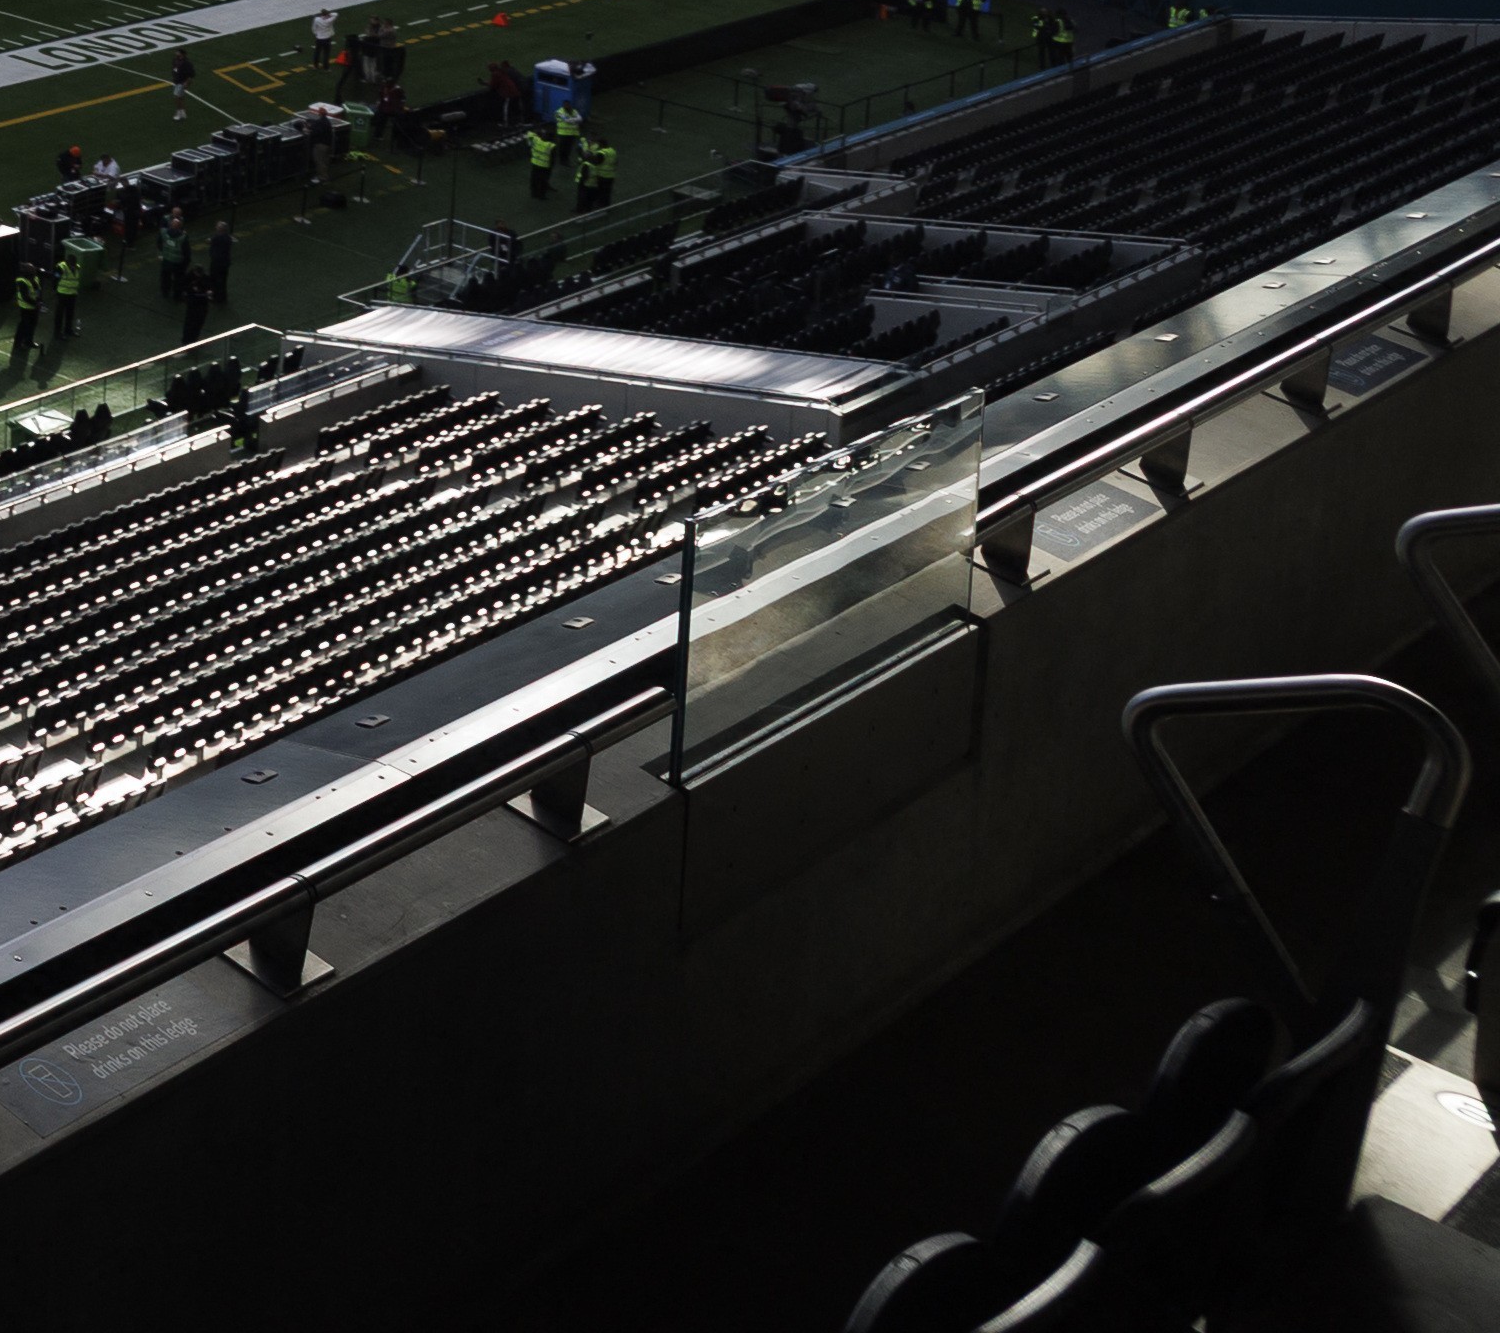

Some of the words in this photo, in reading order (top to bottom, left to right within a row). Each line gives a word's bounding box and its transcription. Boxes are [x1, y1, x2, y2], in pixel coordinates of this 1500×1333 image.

[5, 18, 221, 71] LONDON
[62, 1034, 110, 1060] Please
[102, 1024, 124, 1041] do
[120, 1013, 145, 1033] not
[138, 999, 173, 1026] place
[90, 1053, 133, 1080] drinks
[127, 1044, 148, 1060] on
[139, 1032, 169, 1052] this
[161, 1016, 198, 1040] ledge
